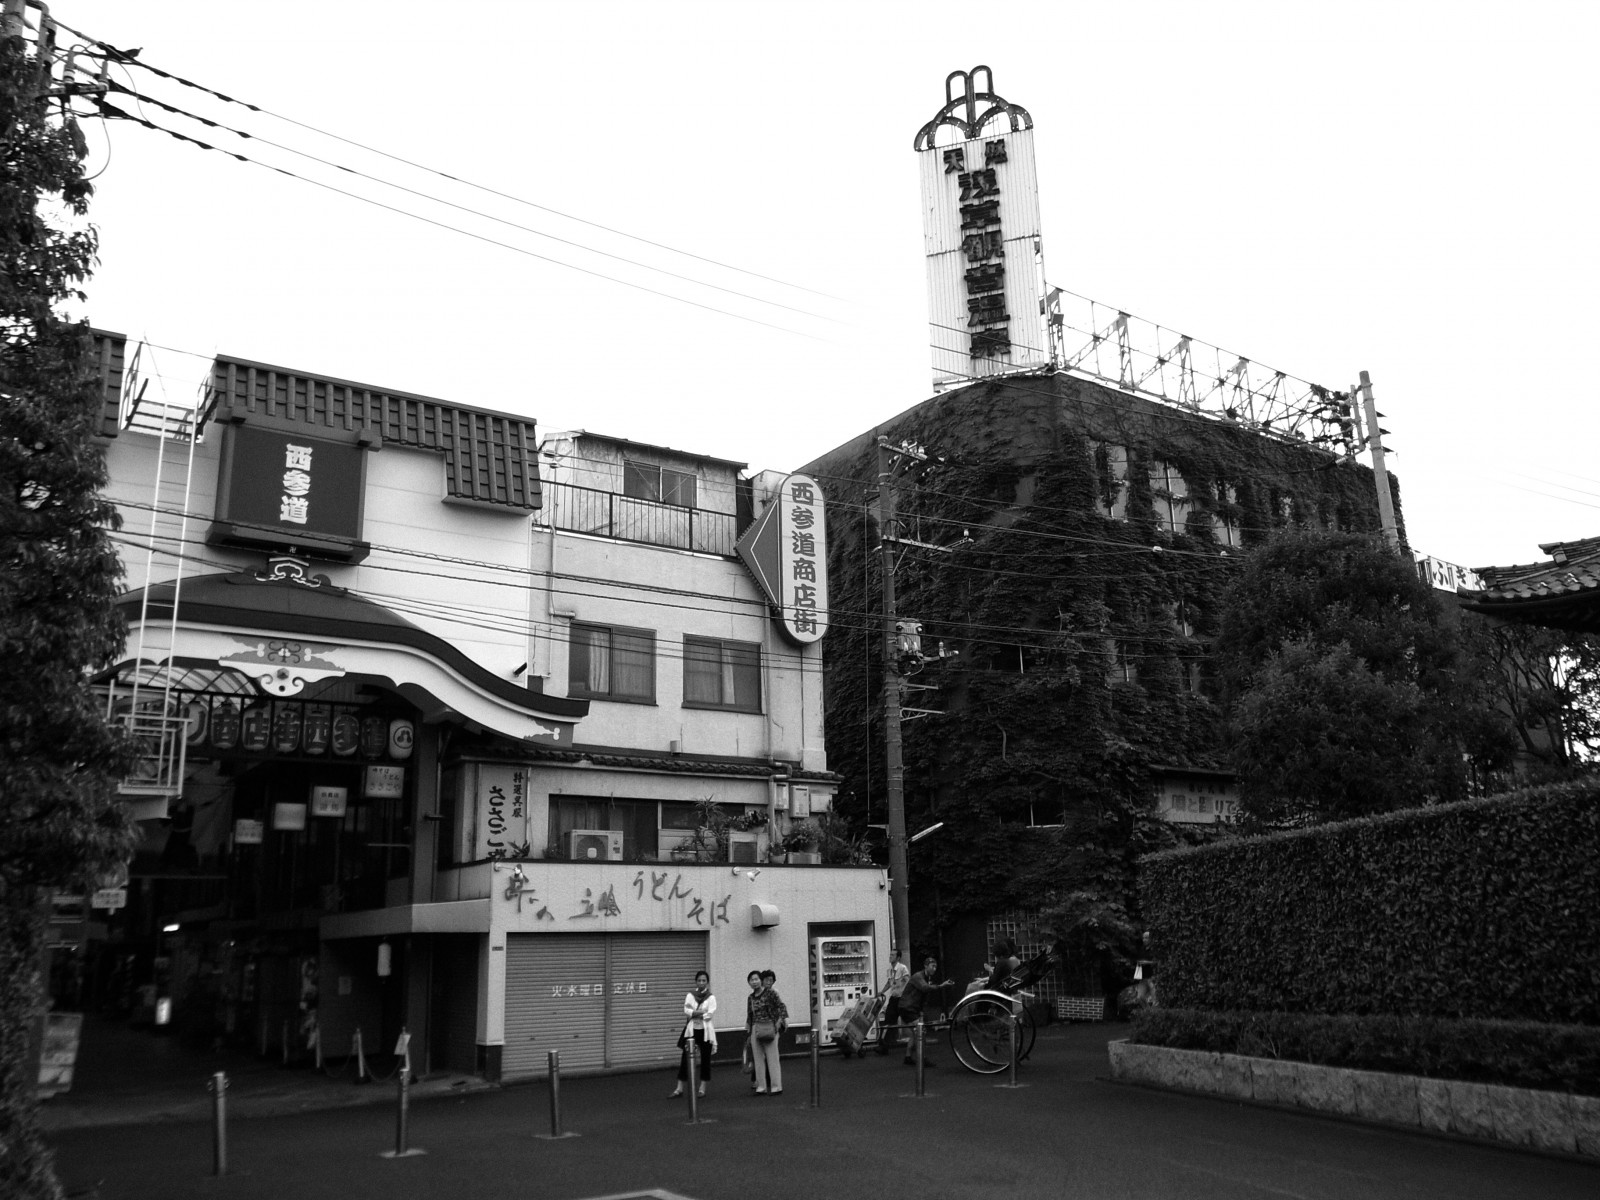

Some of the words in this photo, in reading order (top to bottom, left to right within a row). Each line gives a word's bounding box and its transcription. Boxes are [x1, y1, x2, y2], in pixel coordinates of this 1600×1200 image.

[943, 138, 1008, 174] 天然
[957, 168, 1011, 359] 浅草観音温泉
[791, 482, 817, 635] 西参道商店街
[687, 894, 732, 926] そば
